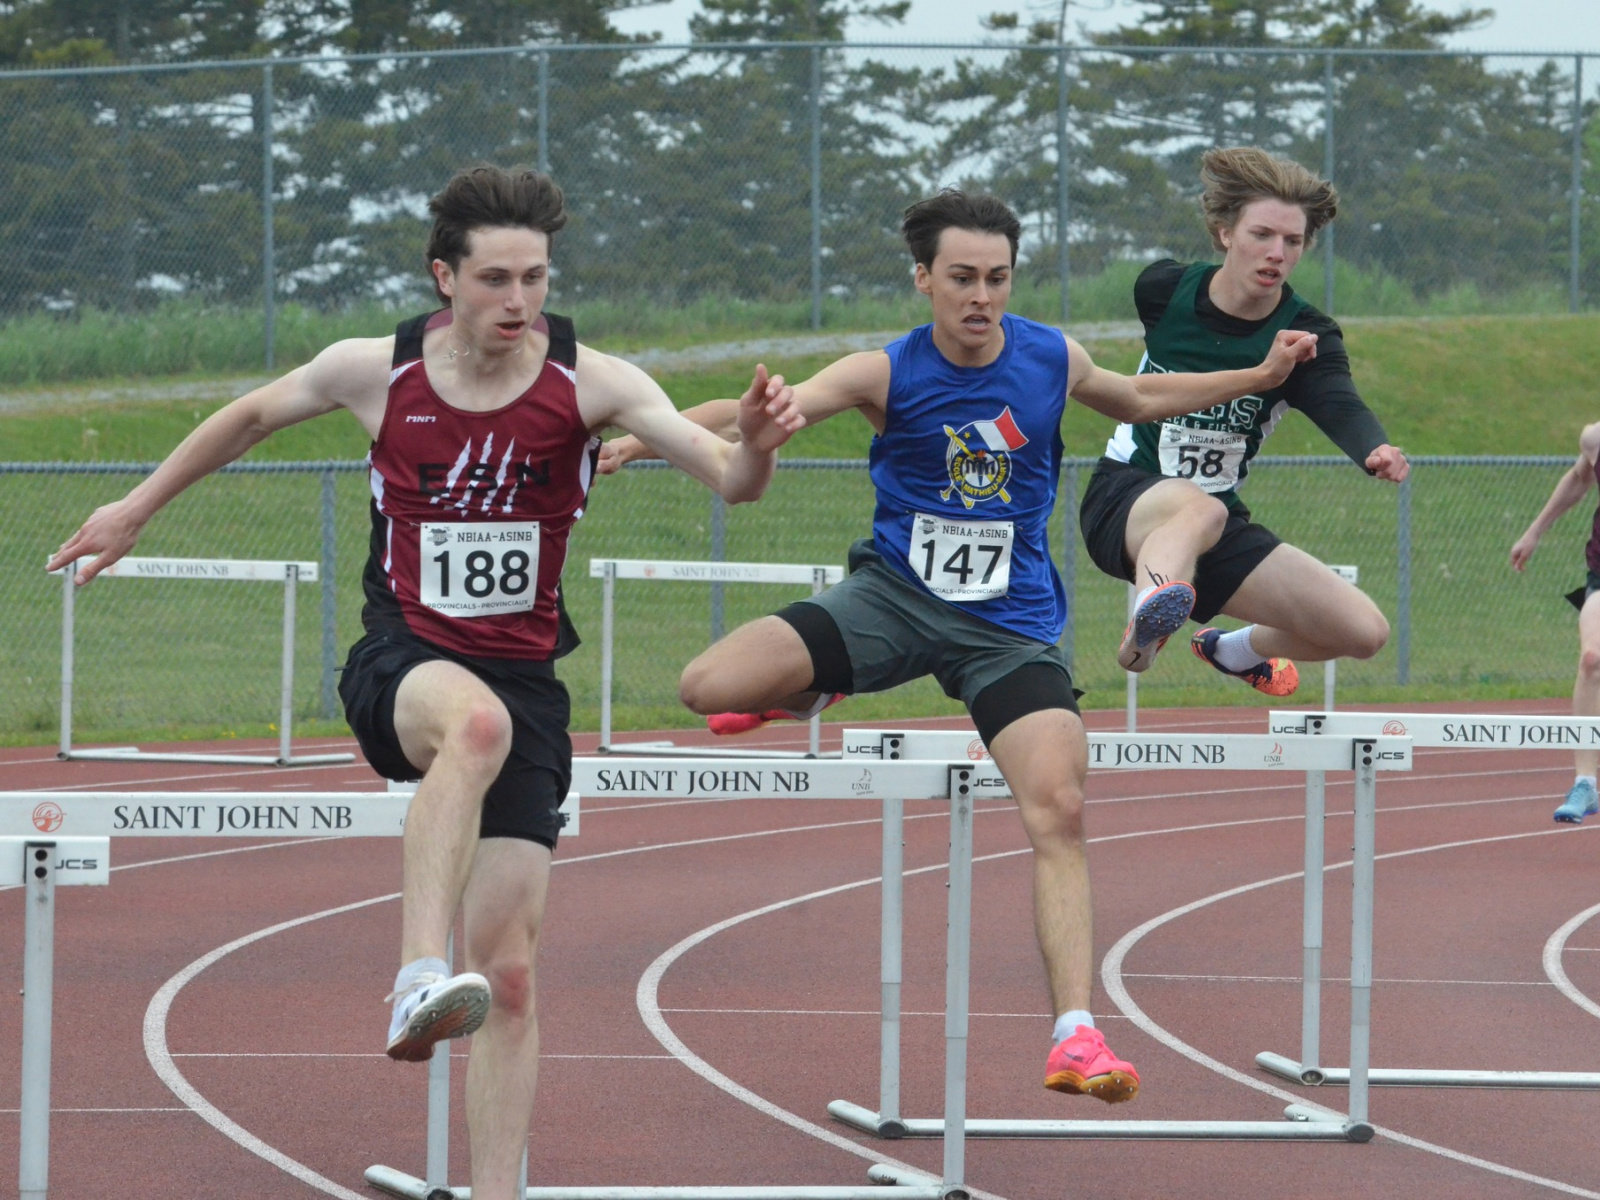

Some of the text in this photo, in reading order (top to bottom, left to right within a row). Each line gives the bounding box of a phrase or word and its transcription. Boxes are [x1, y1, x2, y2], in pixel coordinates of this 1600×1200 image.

[405, 415, 437, 423] MNM
[1177, 446, 1225, 479] 58
[418, 461, 550, 499] ESN
[457, 531, 533, 543] NBIAA-ASINB
[942, 524, 1008, 539] NBIAA-ASINB
[136, 563, 229, 577] SAINT JOHN NB
[922, 539, 1004, 585] 147
[433, 549, 530, 599] 188
[1272, 725, 1306, 735] UCS
[1442, 723, 1511, 743] SAINT
[1519, 724, 1582, 746] JOHN
[847, 745, 882, 754] UCS
[1115, 743, 1183, 766] JOHN
[1192, 744, 1226, 764] NB
[1263, 755, 1281, 763] UNB
[597, 769, 810, 795] SAINT JOHN NB
[852, 782, 871, 790] UNB
[113, 805, 353, 833] SAINT JOHN NB
